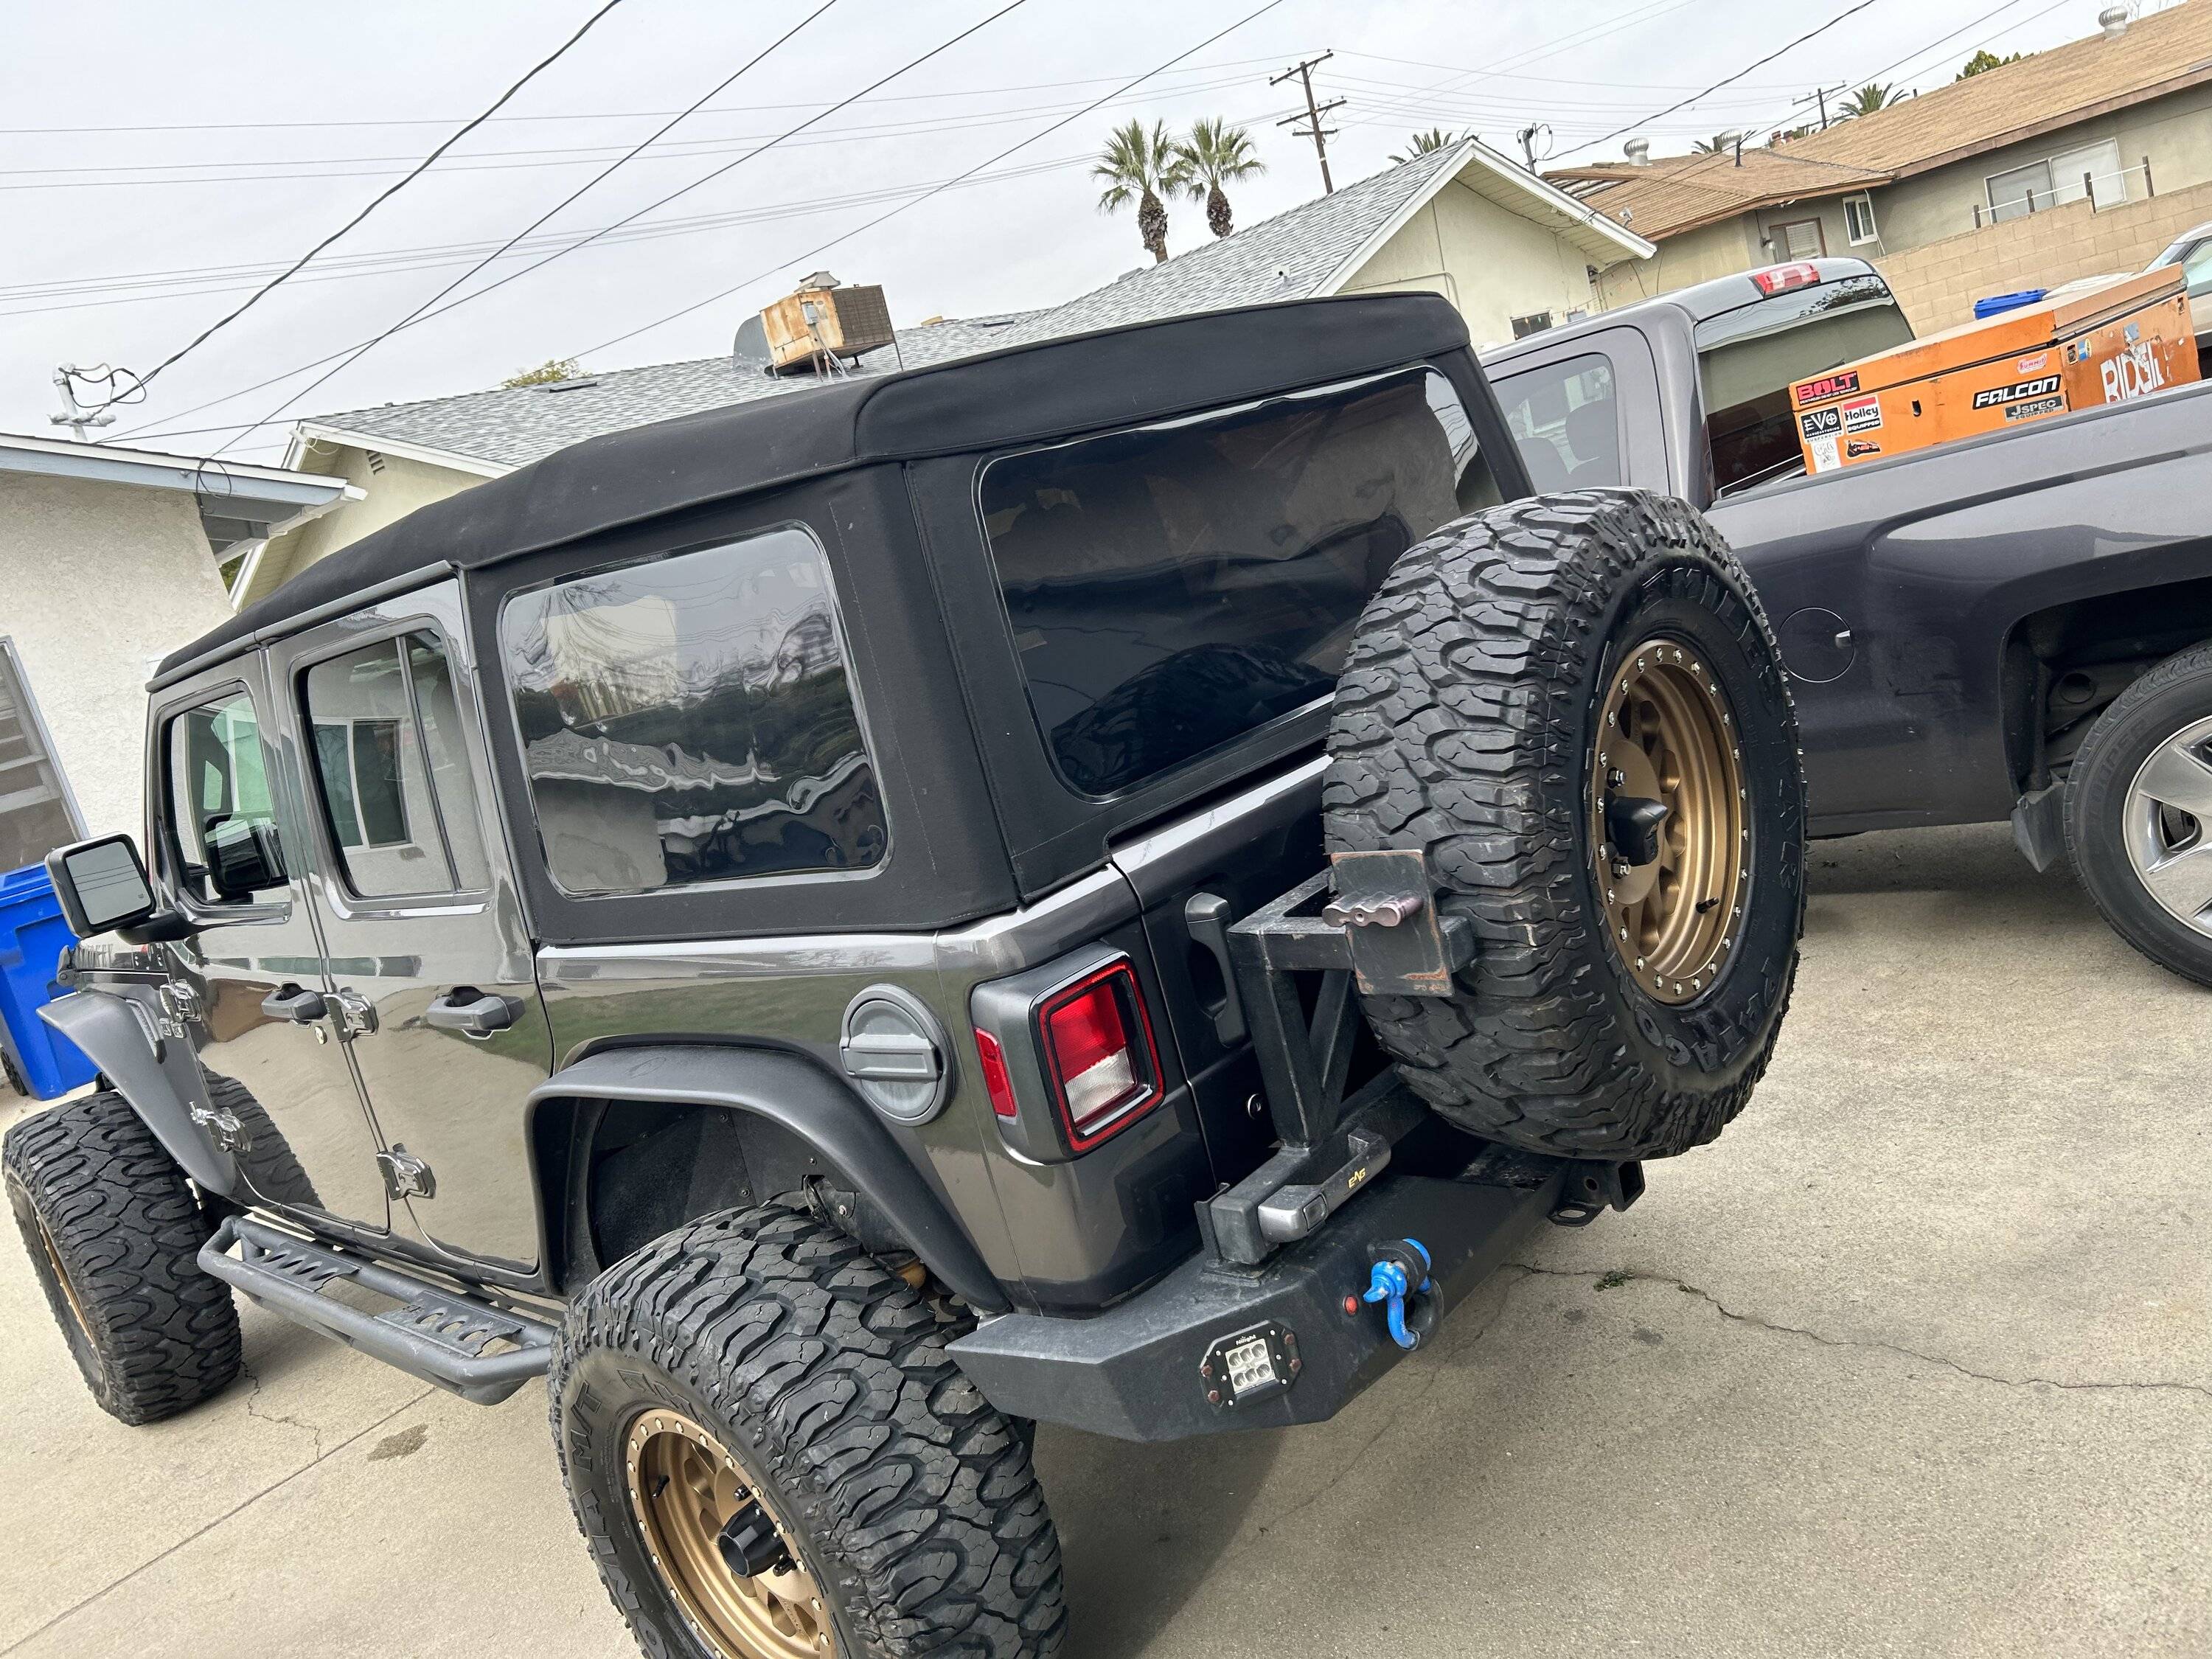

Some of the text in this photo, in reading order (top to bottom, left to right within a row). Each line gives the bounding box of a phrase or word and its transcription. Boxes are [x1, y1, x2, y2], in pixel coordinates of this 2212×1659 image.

[1798, 373, 1856, 400] BOLT
[1975, 377, 2058, 407] FALCON
[1845, 407, 1879, 422] Holley
[2011, 399, 2056, 416] JSPEC
[1804, 411, 1837, 431] EVO
